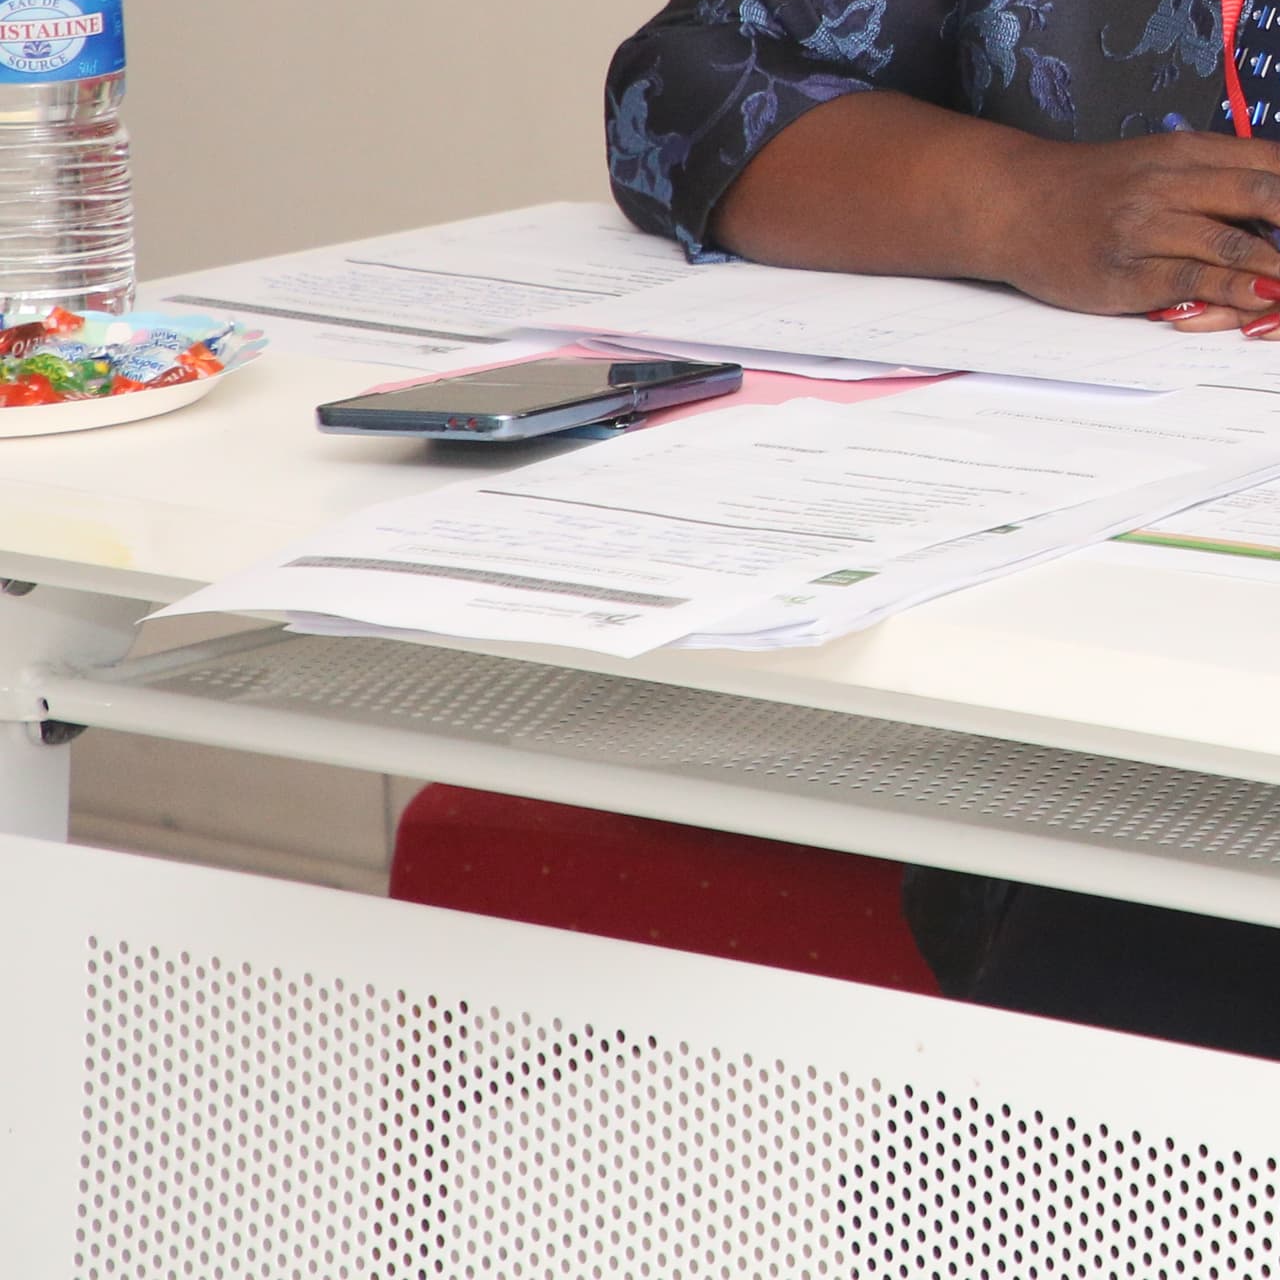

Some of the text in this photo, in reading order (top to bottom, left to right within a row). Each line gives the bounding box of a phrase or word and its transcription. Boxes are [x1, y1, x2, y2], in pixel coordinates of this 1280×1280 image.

[0, 17, 100, 40] ISTALINE
[8, 53, 68, 72] SOURCE
[128, 354, 165, 373] Super
